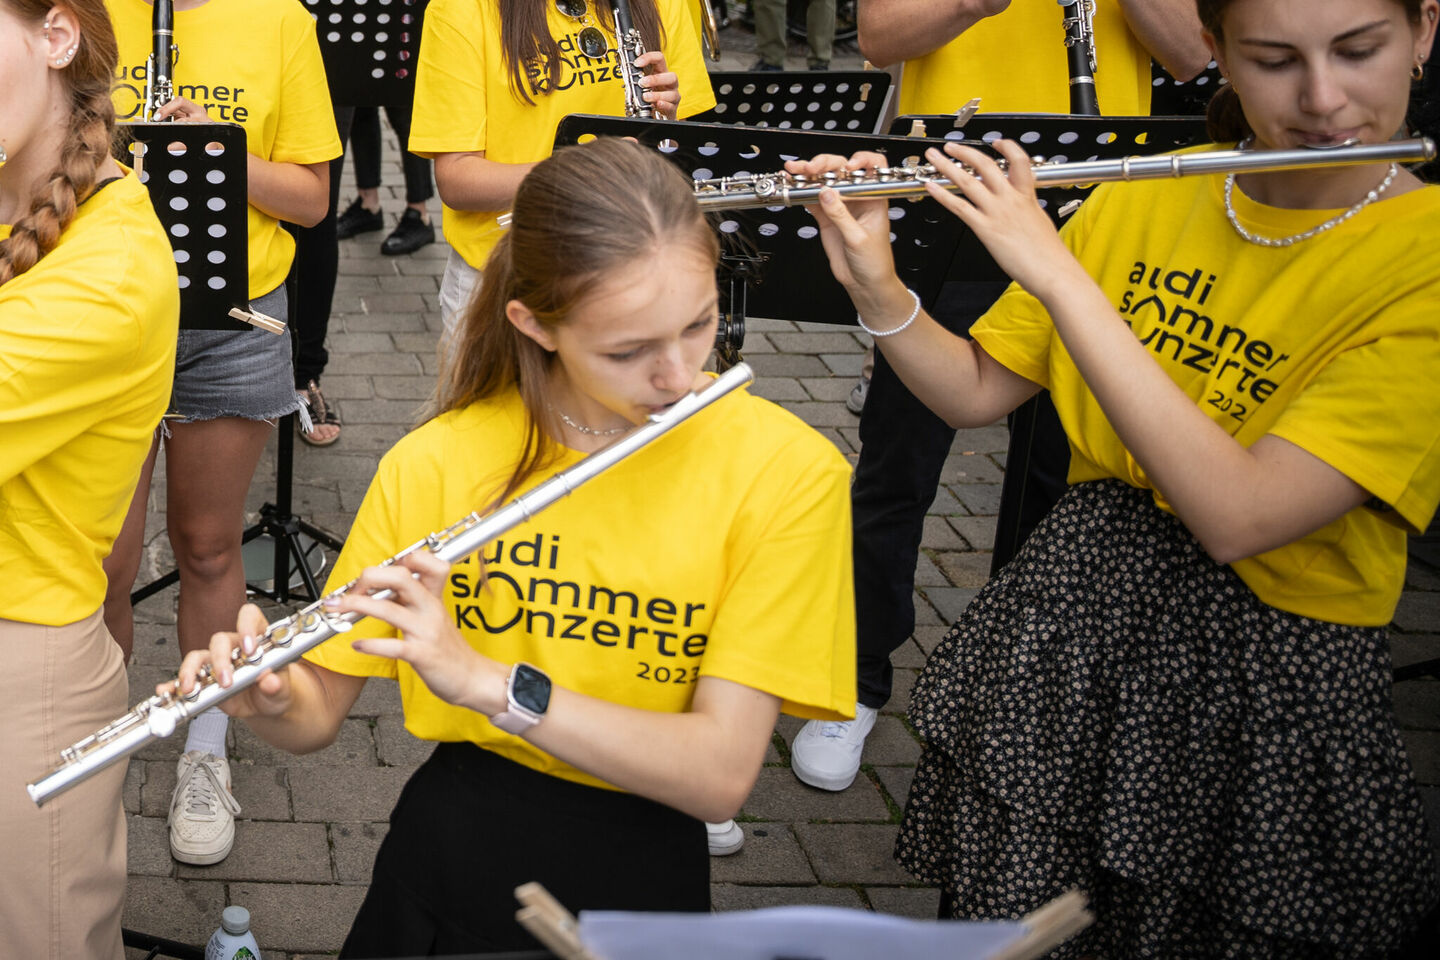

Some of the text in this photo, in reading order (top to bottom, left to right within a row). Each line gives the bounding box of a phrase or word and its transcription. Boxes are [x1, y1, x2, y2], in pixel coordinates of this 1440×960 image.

[1207, 390, 1248, 422] 202
[456, 533, 560, 570] udi
[450, 571, 706, 628] sommer
[456, 603, 708, 658] konzerte
[636, 661, 700, 685] 2023
